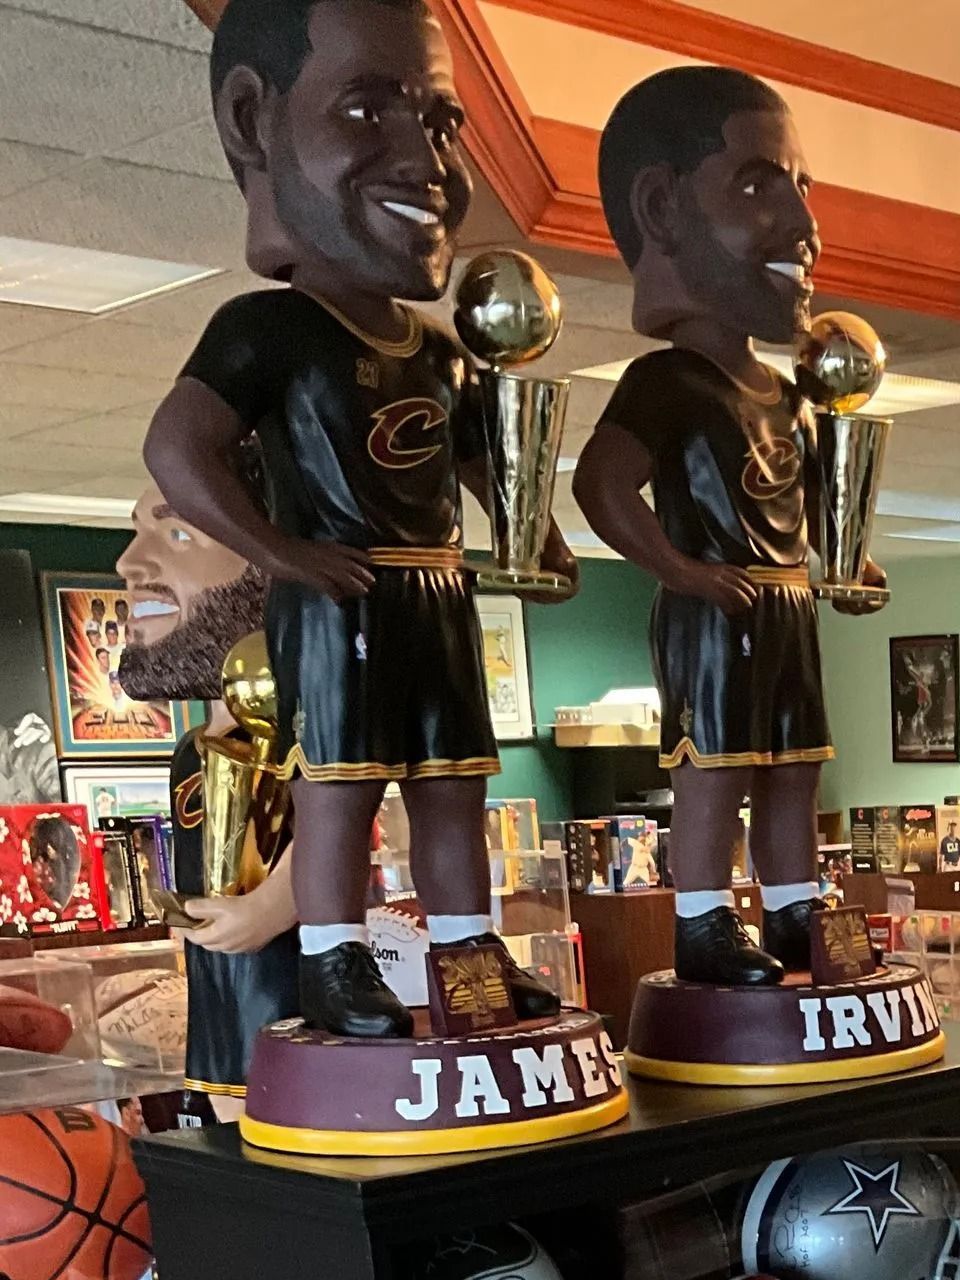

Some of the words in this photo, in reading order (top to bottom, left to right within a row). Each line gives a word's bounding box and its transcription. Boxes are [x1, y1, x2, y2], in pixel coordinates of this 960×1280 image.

[367, 397, 447, 469] C
[734, 437, 799, 500] C
[371, 940, 400, 962] lson
[395, 1031, 623, 1121] JAMES
